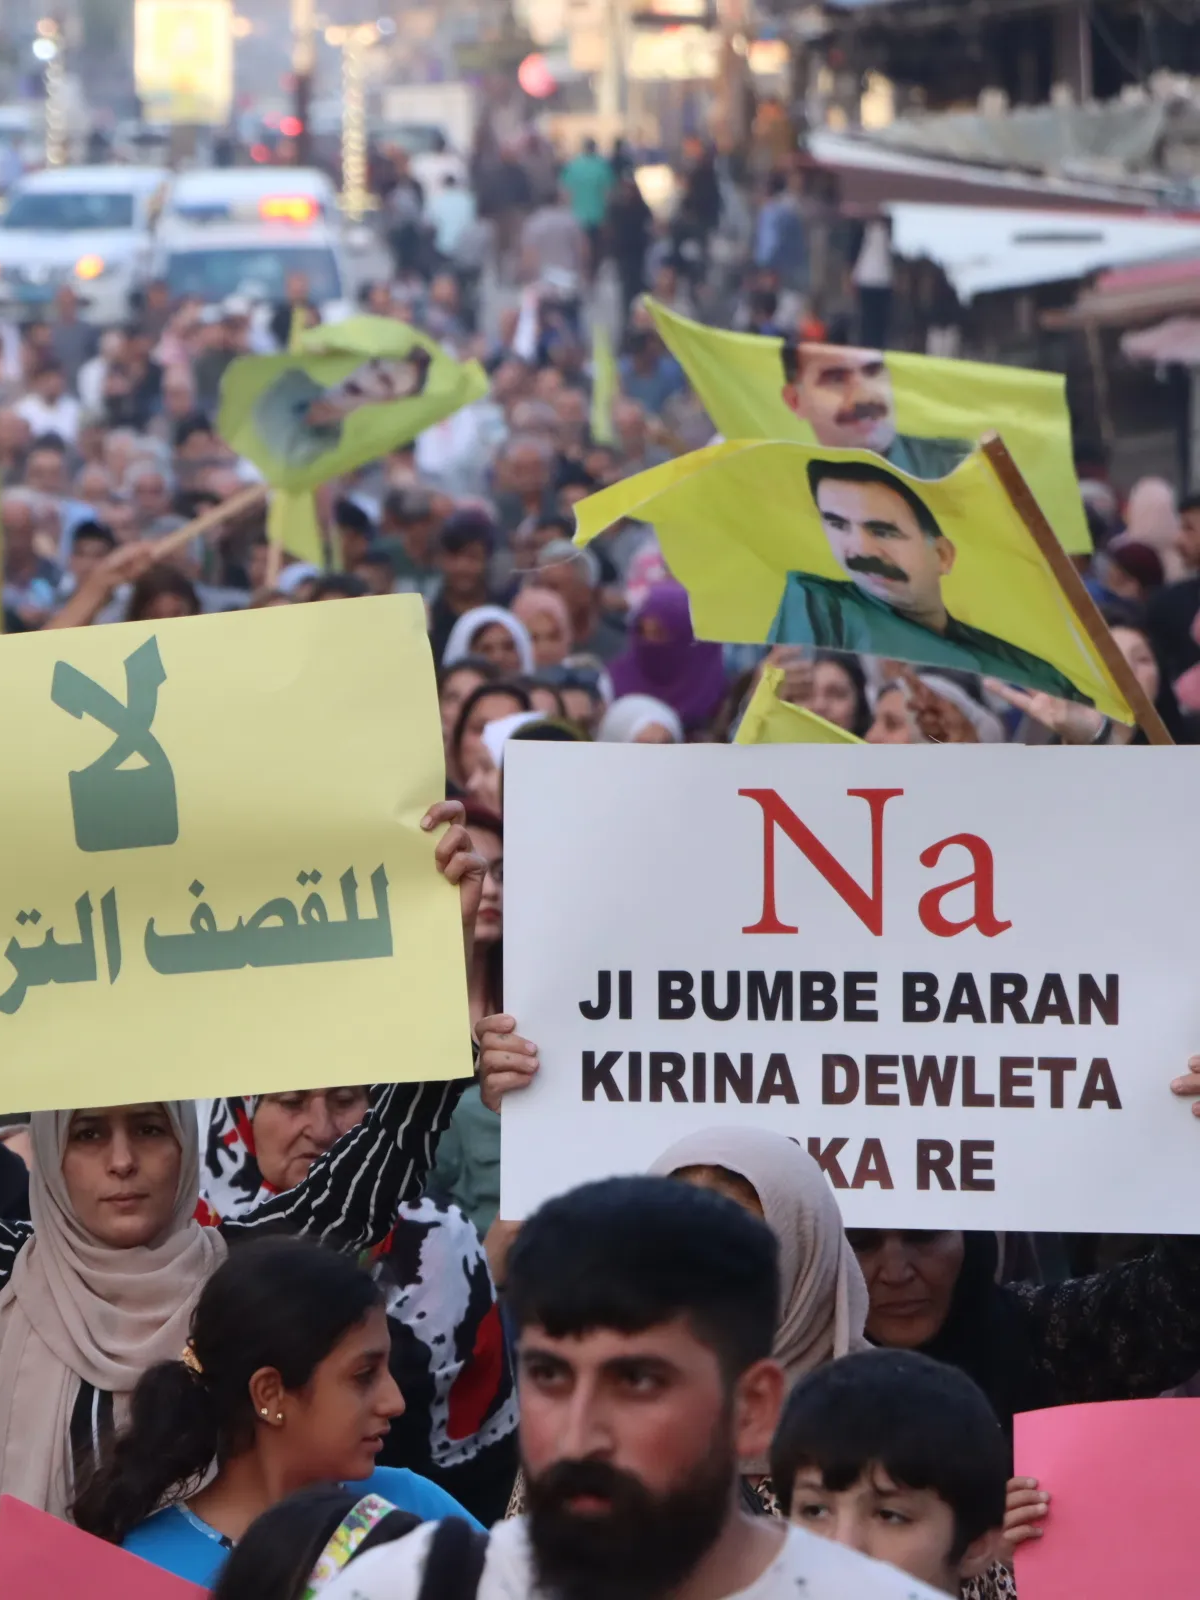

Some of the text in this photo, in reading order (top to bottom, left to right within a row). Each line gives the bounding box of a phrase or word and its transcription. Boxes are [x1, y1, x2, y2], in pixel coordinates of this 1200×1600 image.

[50, 634, 180, 853] لا
[738, 788, 1013, 938] Na
[143, 862, 394, 976] للقصف
[578, 969, 1120, 1026] JI BUMBE BARAN
[581, 1050, 1123, 1110] KIRINA DEWLETA
[787, 1136, 996, 1192] KA RE
